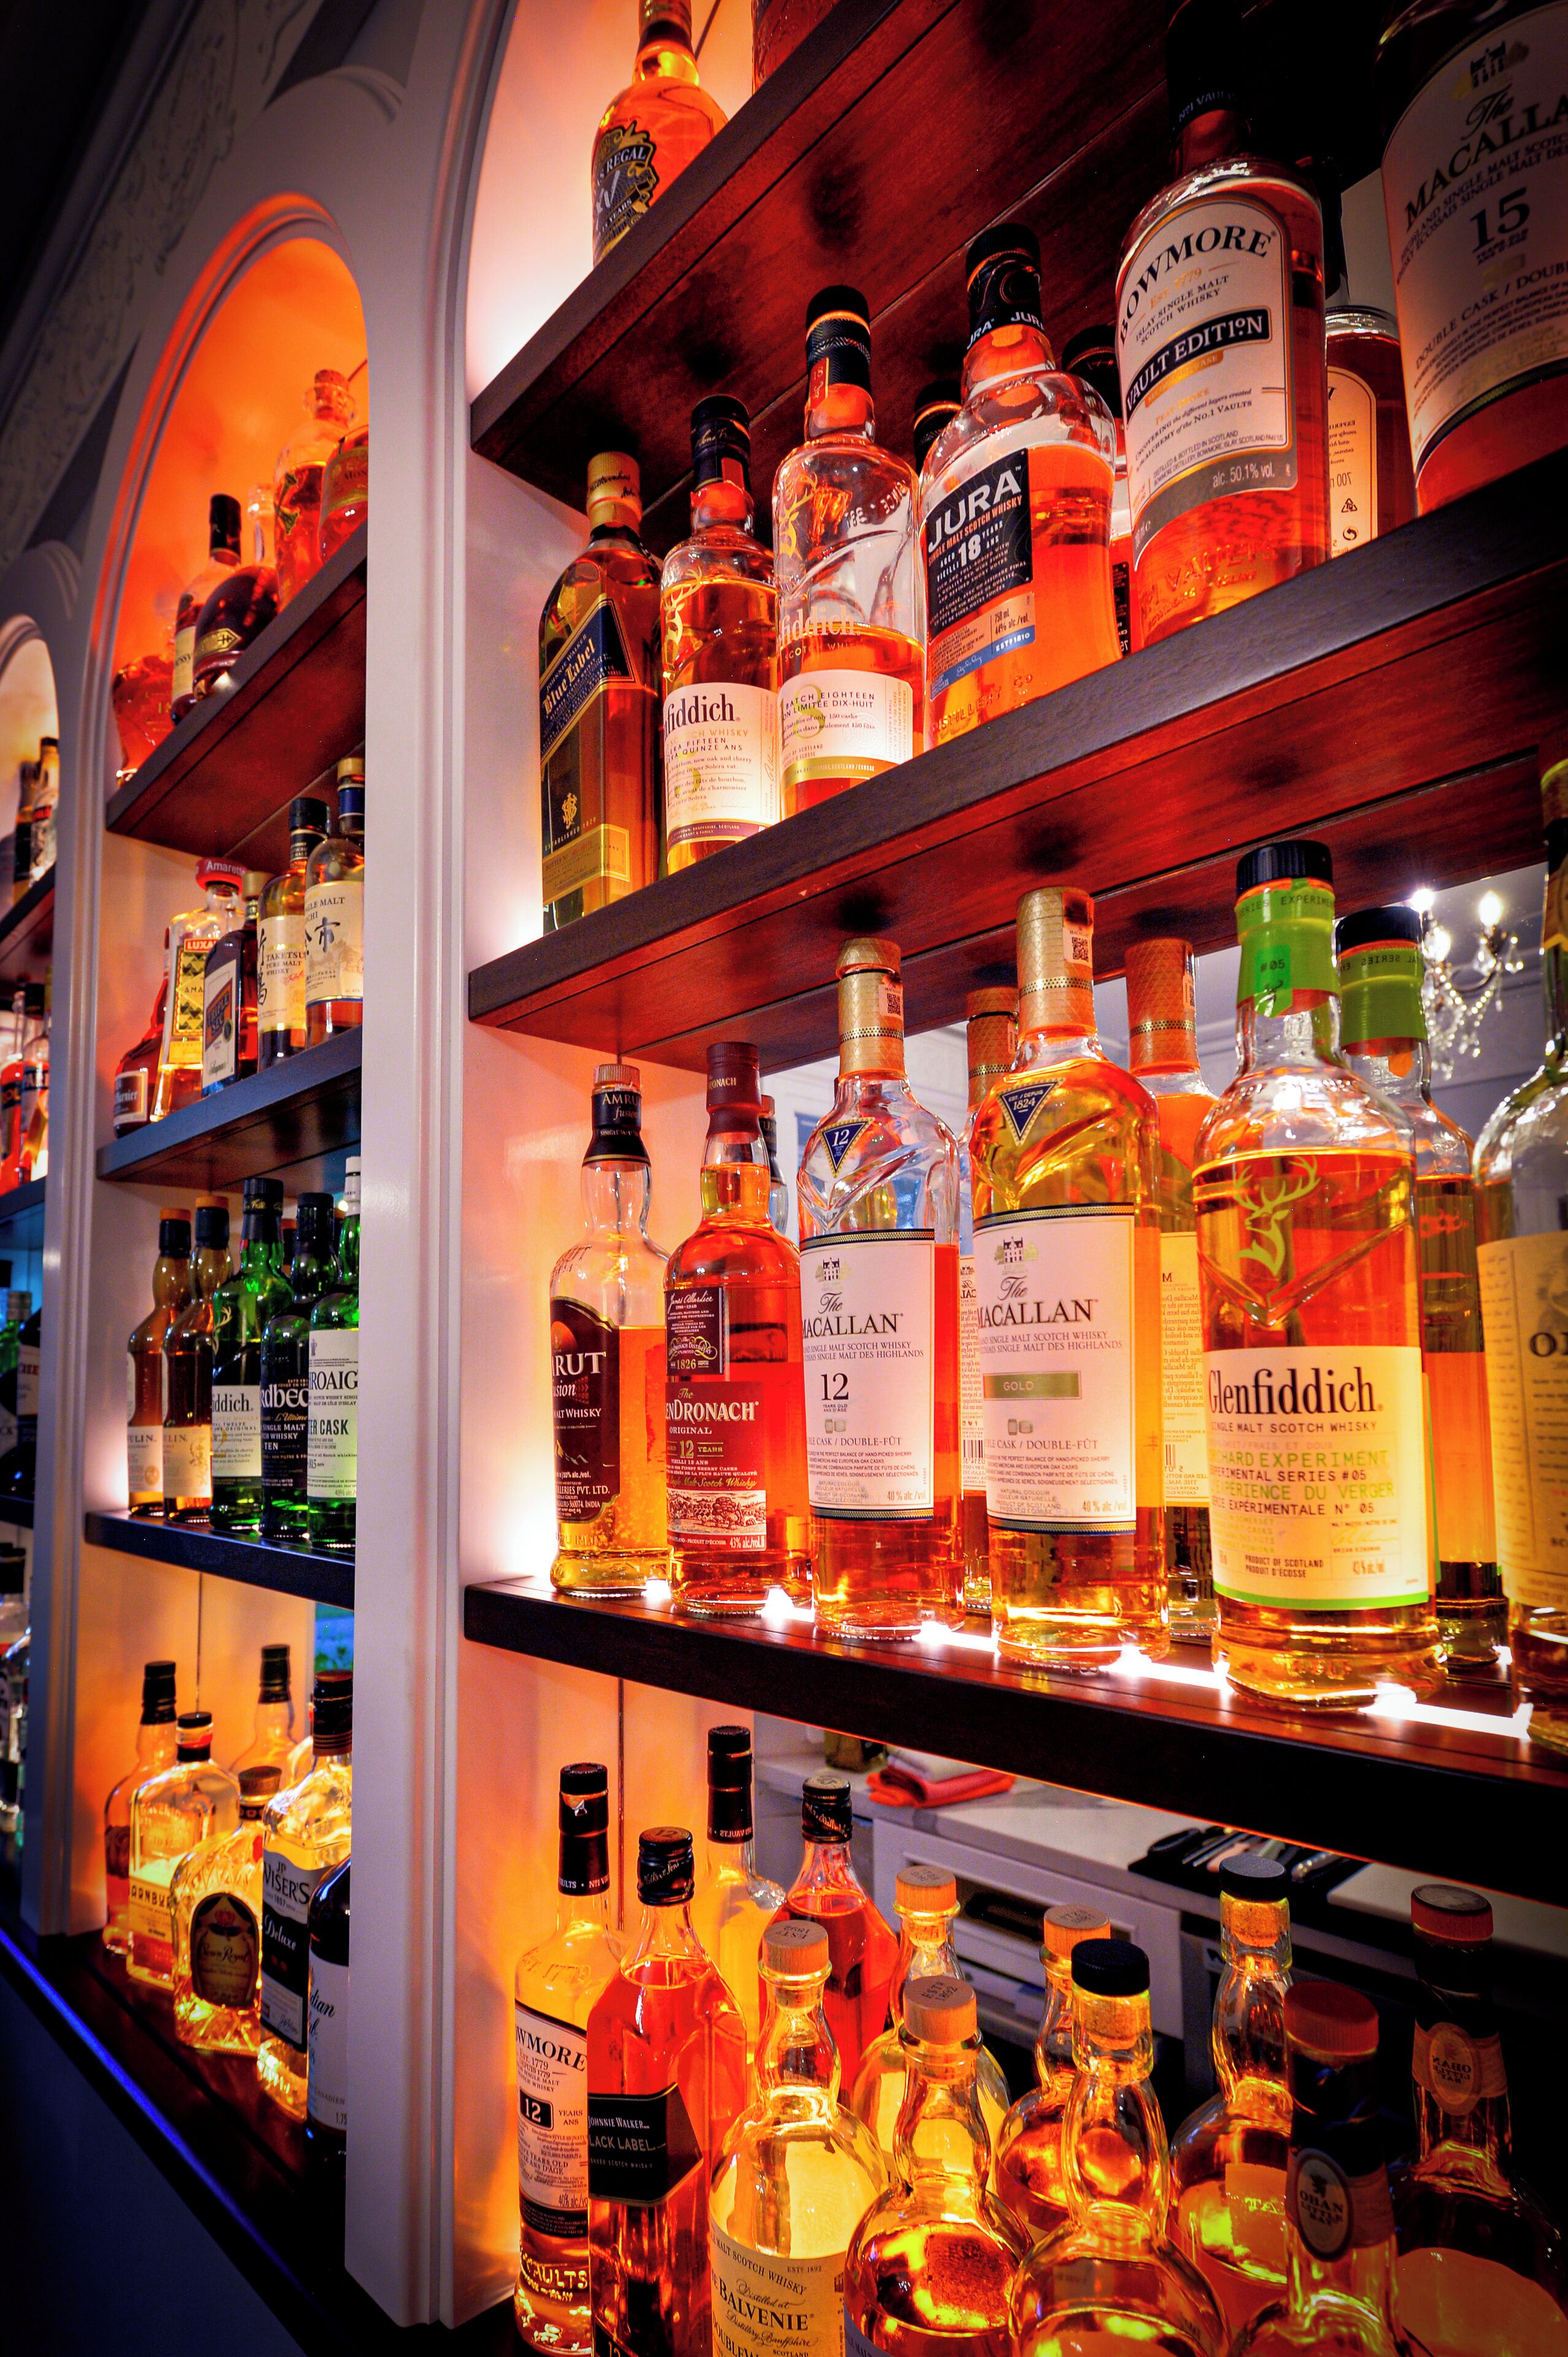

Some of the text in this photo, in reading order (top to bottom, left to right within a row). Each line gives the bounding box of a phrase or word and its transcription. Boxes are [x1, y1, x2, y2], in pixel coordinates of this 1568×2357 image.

[1461, 83, 1514, 140] The
[606, 146, 646, 172] REGAL
[610, 199, 631, 222] YEARS
[1470, 187, 1531, 253] 15
[1120, 225, 1271, 346] BOWMORE
[1135, 275, 1229, 341] ISLAY SINGLE MALT
[1141, 288, 1221, 346] SCOTCH WHISKY
[1416, 289, 1499, 369] DOUBLE CASK
[1126, 351, 1170, 411] VAULT
[1218, 400, 1252, 413] VAULTS
[1135, 388, 1252, 460] UNCOVERING different layers created
[1178, 431, 1238, 460] BOTTLED SCOTLAND
[1213, 462, 1275, 489] alc. 50.1% vol.
[929, 470, 1021, 553] JURA
[929, 496, 1022, 567] SINGLE MALT SCOTCH WHISKY
[940, 521, 1003, 568] AGED 18 YEARS
[986, 535, 999, 548] ANS
[780, 604, 856, 646] fiddich
[543, 678, 568, 714] Blue
[565, 638, 596, 683] Label
[786, 692, 875, 710] BATCH EIGHTEEN
[832, 699, 873, 708] DIX-HUIT
[709, 729, 748, 738] WHISKY
[682, 745, 718, 756] QUINZE
[687, 738, 726, 747] FIFTEEN
[320, 897, 345, 907] MALT
[1260, 959, 1285, 972] #05
[1013, 1097, 1035, 1110] 1824
[832, 1129, 850, 1147] 12
[998, 1275, 1028, 1300] The
[818, 1292, 843, 1315] The
[1033, 1333, 1068, 1342] SCOTCH
[1073, 1331, 1108, 1340] WHISKY
[811, 1341, 911, 1353] SINGLE MALT SCOTCH WHISKY
[876, 1349, 924, 1358] HIGHLANDS
[1068, 1341, 1122, 1350] HIGHLANDS
[677, 1358, 697, 1370] 1826
[678, 1388, 695, 1401] The
[821, 1372, 849, 1402] 12
[1003, 1381, 1033, 1391] GOLD
[1208, 1366, 1377, 1415] Glenfiddich
[565, 1408, 601, 1418] WHISKY
[320, 1420, 349, 1435] CASK
[670, 1426, 713, 1434] ORIGINAL
[1237, 1421, 1377, 1433] MALT SCOTCH WHISKY
[265, 1442, 279, 1450] TEN
[679, 1440, 695, 1459] 12
[817, 1436, 902, 1446] CASK DOUBLE-FÛT
[997, 1439, 1098, 1449] CASK DOUBLE-FÛT
[1260, 1450, 1389, 1468] EXPERIMENT
[698, 1476, 757, 1490] Scotch Whisky
[1278, 1470, 1335, 1482] SERIES
[577, 1485, 610, 1495] PVT. LTD.
[1305, 1482, 1395, 1500] DU VERGER
[1229, 1498, 1375, 1515] EXPÉRIMENTALE 05
[730, 1536, 742, 1549] 43%
[1245, 1554, 1324, 1568] PRODUCT OF SCOTLAND
[1246, 1565, 1307, 1578] PRODUIT D'ÉCOSSE
[277, 1862, 286, 1873] JP
[265, 1914, 296, 1950] Deluxe
[532, 2056, 549, 2070] 1779
[525, 2098, 541, 2123] 12
[588, 2115, 644, 2129] JOHNNIE WALKER
[589, 2134, 655, 2152] LACK LABEL
[1300, 2189, 1343, 2213] OBAN
[1310, 2211, 1332, 2226] BAY
[716, 2237, 807, 2296] MALT SCOTCH WHISKY
[736, 2278, 778, 2308] Distilled
[719, 2276, 808, 2331] BALVENIE
